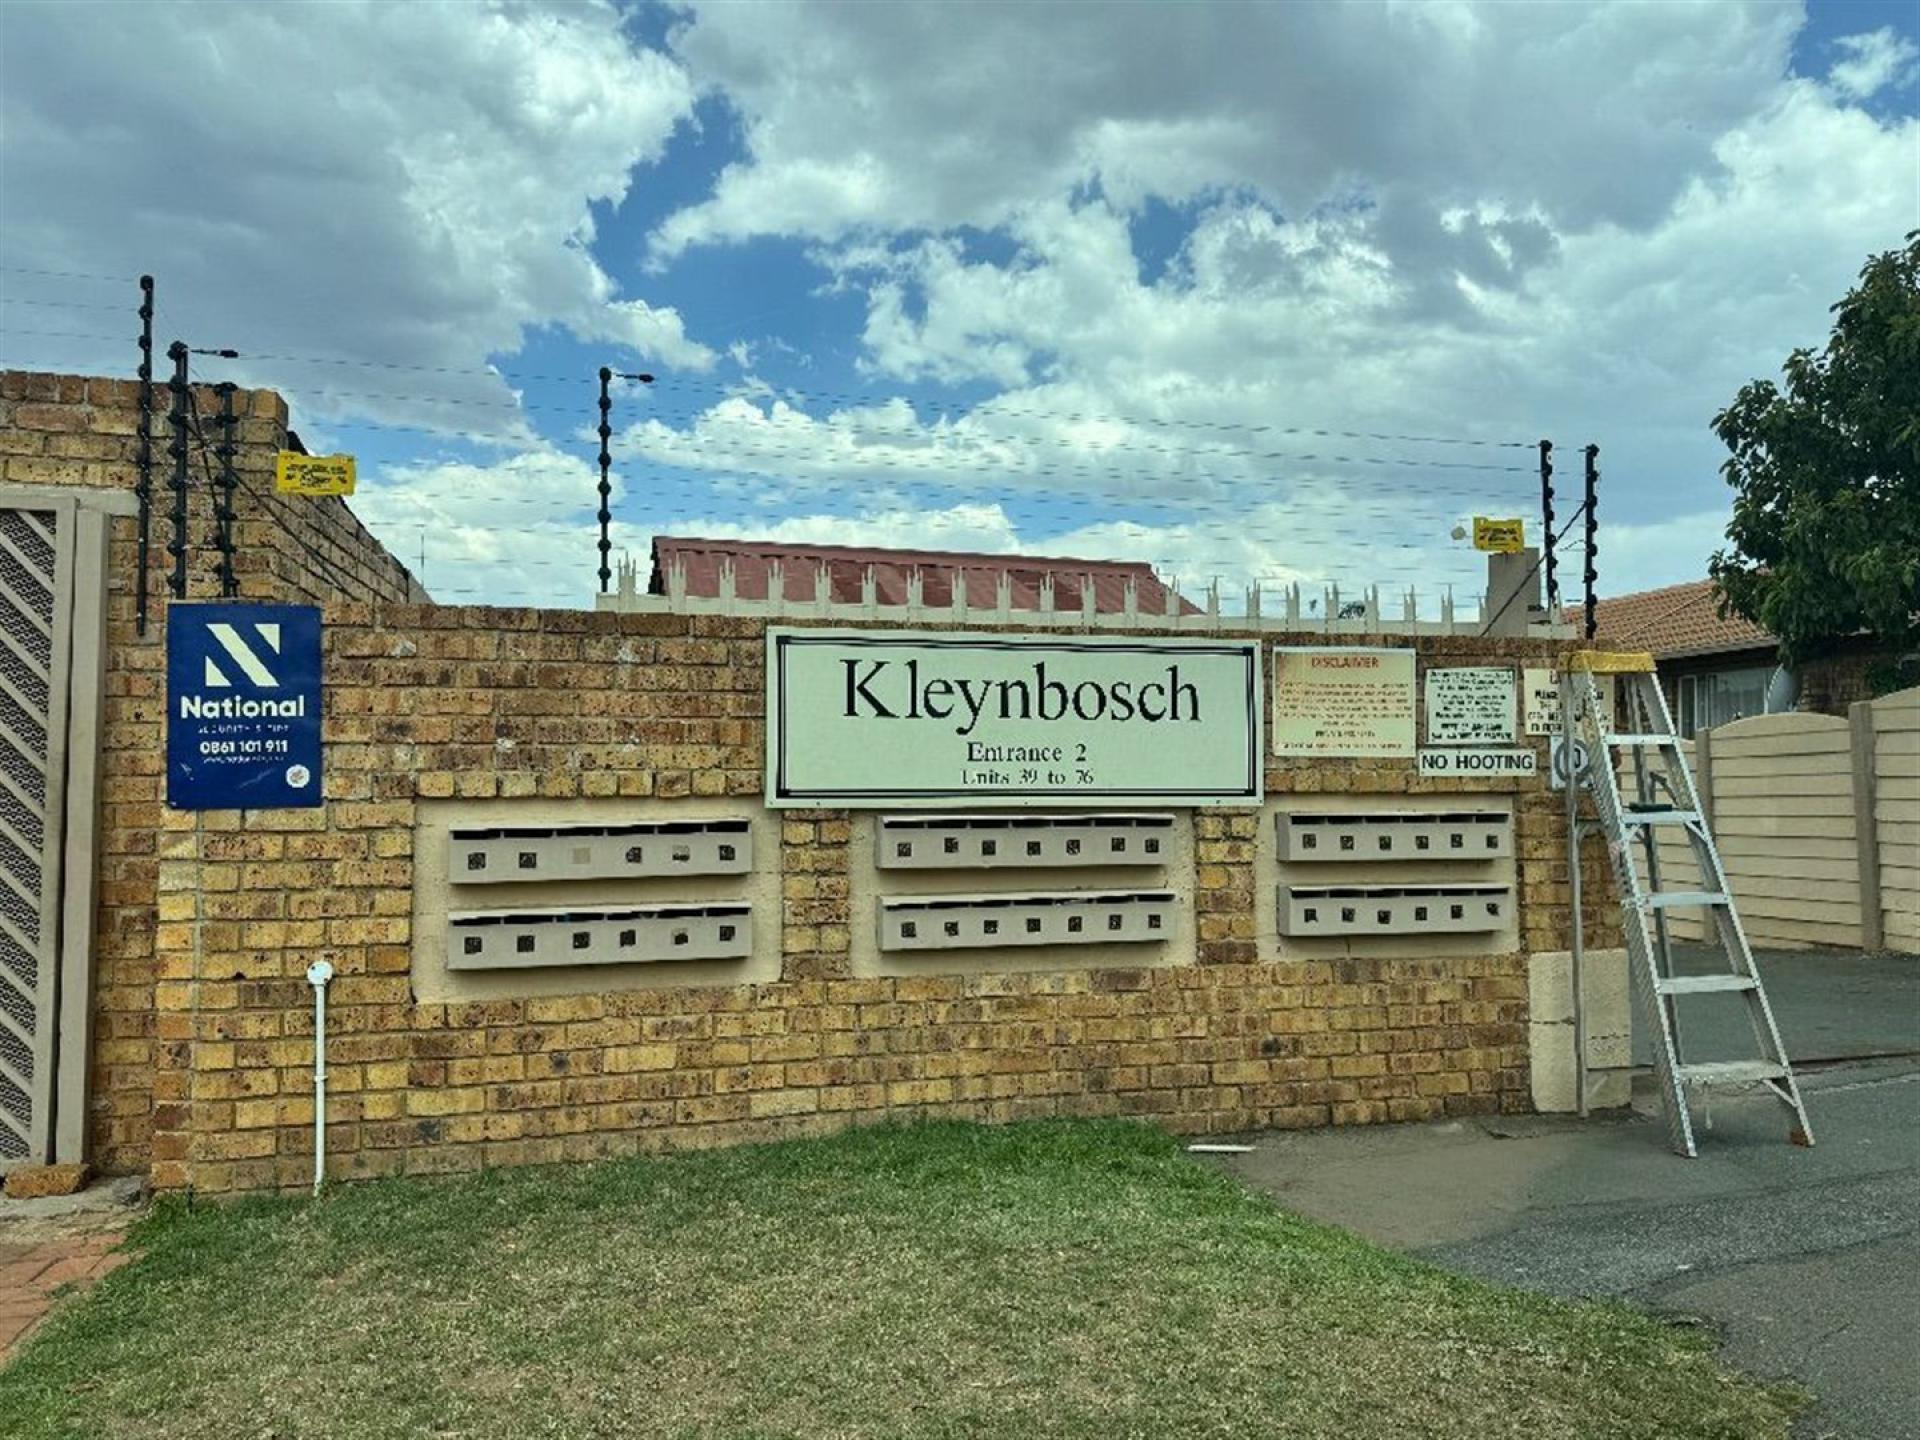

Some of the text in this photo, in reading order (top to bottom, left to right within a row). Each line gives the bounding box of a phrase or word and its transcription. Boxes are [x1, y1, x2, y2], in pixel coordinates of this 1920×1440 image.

[181, 695, 304, 719] National
[840, 659, 1201, 736] Kleynbosch
[200, 740, 288, 755] 0861 101 911
[967, 741, 1087, 763] Entrance 2
[1422, 755, 1533, 769] NO HOOTING
[1019, 768, 1038, 784] 39
[1048, 769, 1066, 784] to
[1075, 768, 1094, 784] 76
